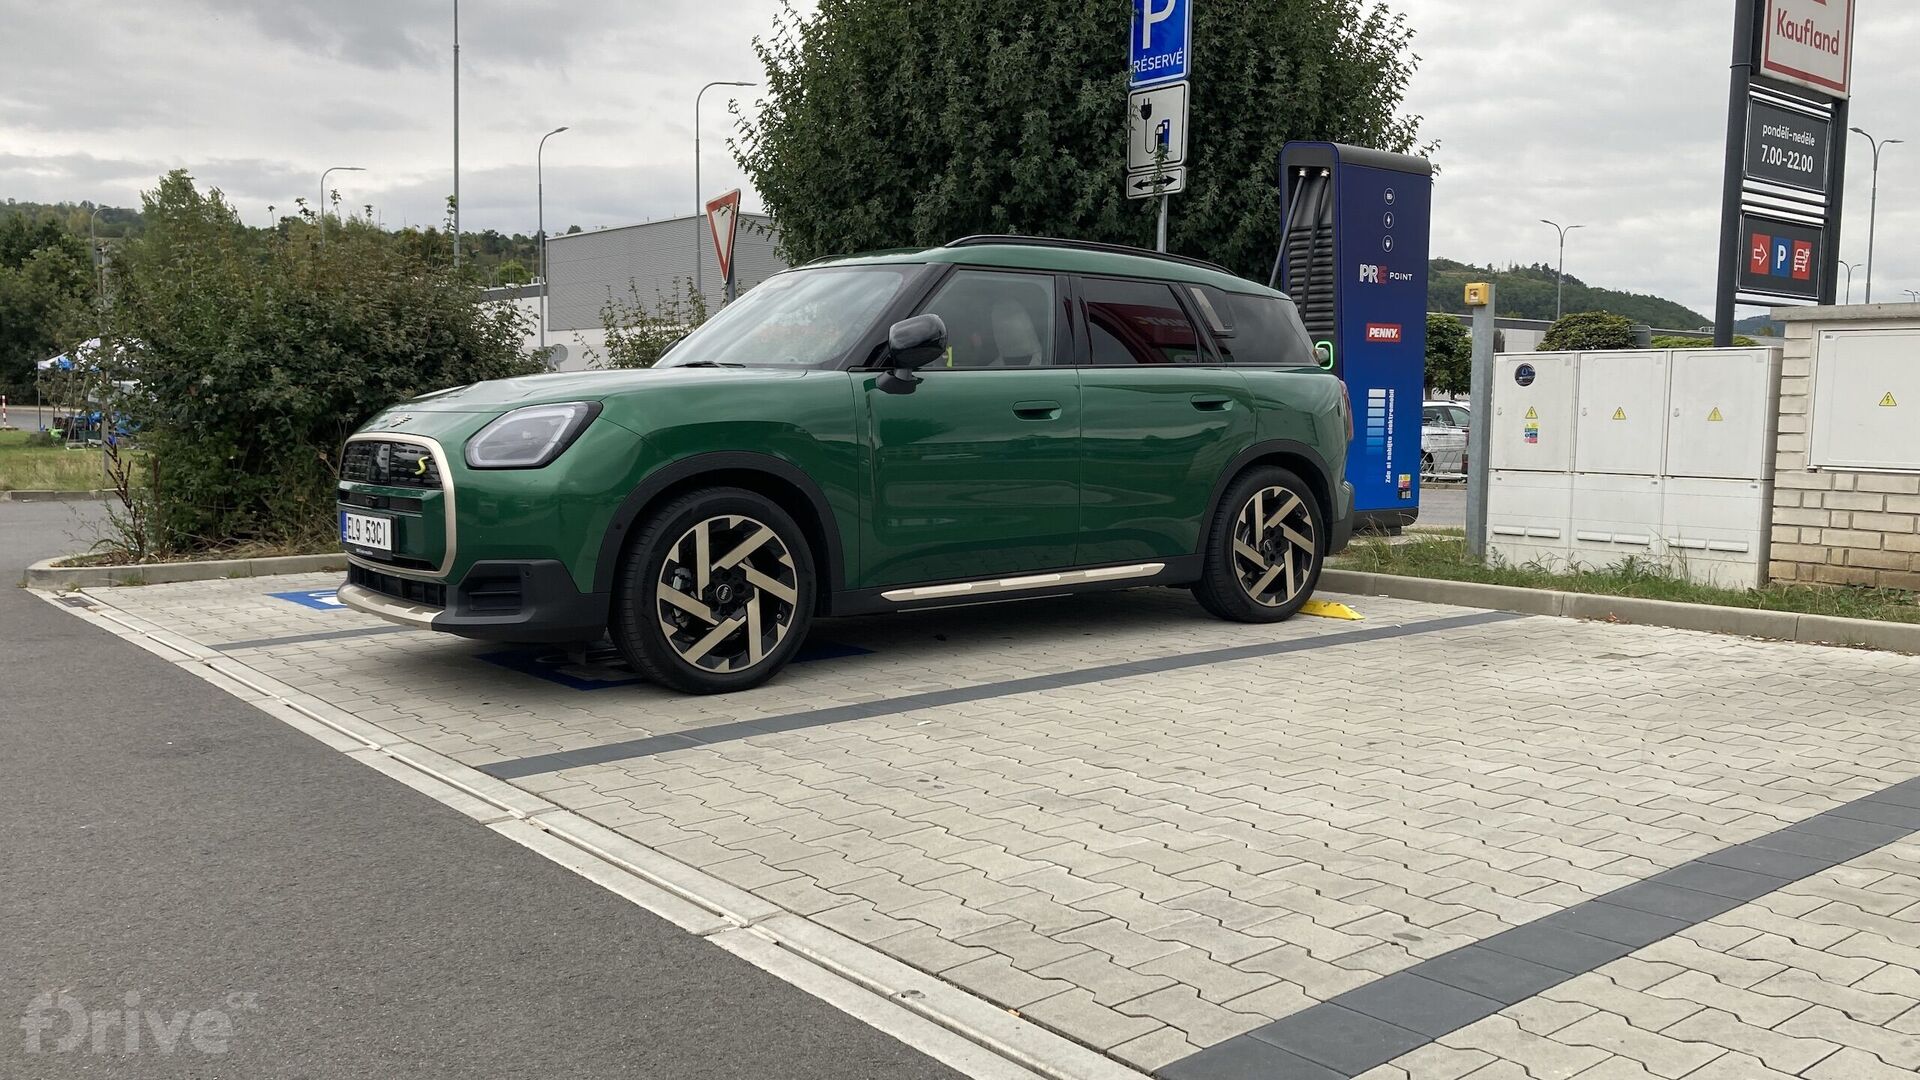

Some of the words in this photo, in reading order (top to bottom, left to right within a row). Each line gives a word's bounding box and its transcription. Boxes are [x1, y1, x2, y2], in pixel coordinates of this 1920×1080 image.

[1142, 0, 1176, 49] P
[1776, 8, 1839, 55] Kaufland
[1133, 47, 1183, 73] RÉSERVÉ
[1762, 124, 1816, 147] pondělí-neděle
[1761, 144, 1814, 173] 7.00-22.00
[1777, 244, 1787, 269] P
[1360, 264, 1387, 284] PRE
[1389, 271, 1413, 281] POINT
[347, 516, 360, 541] EL9
